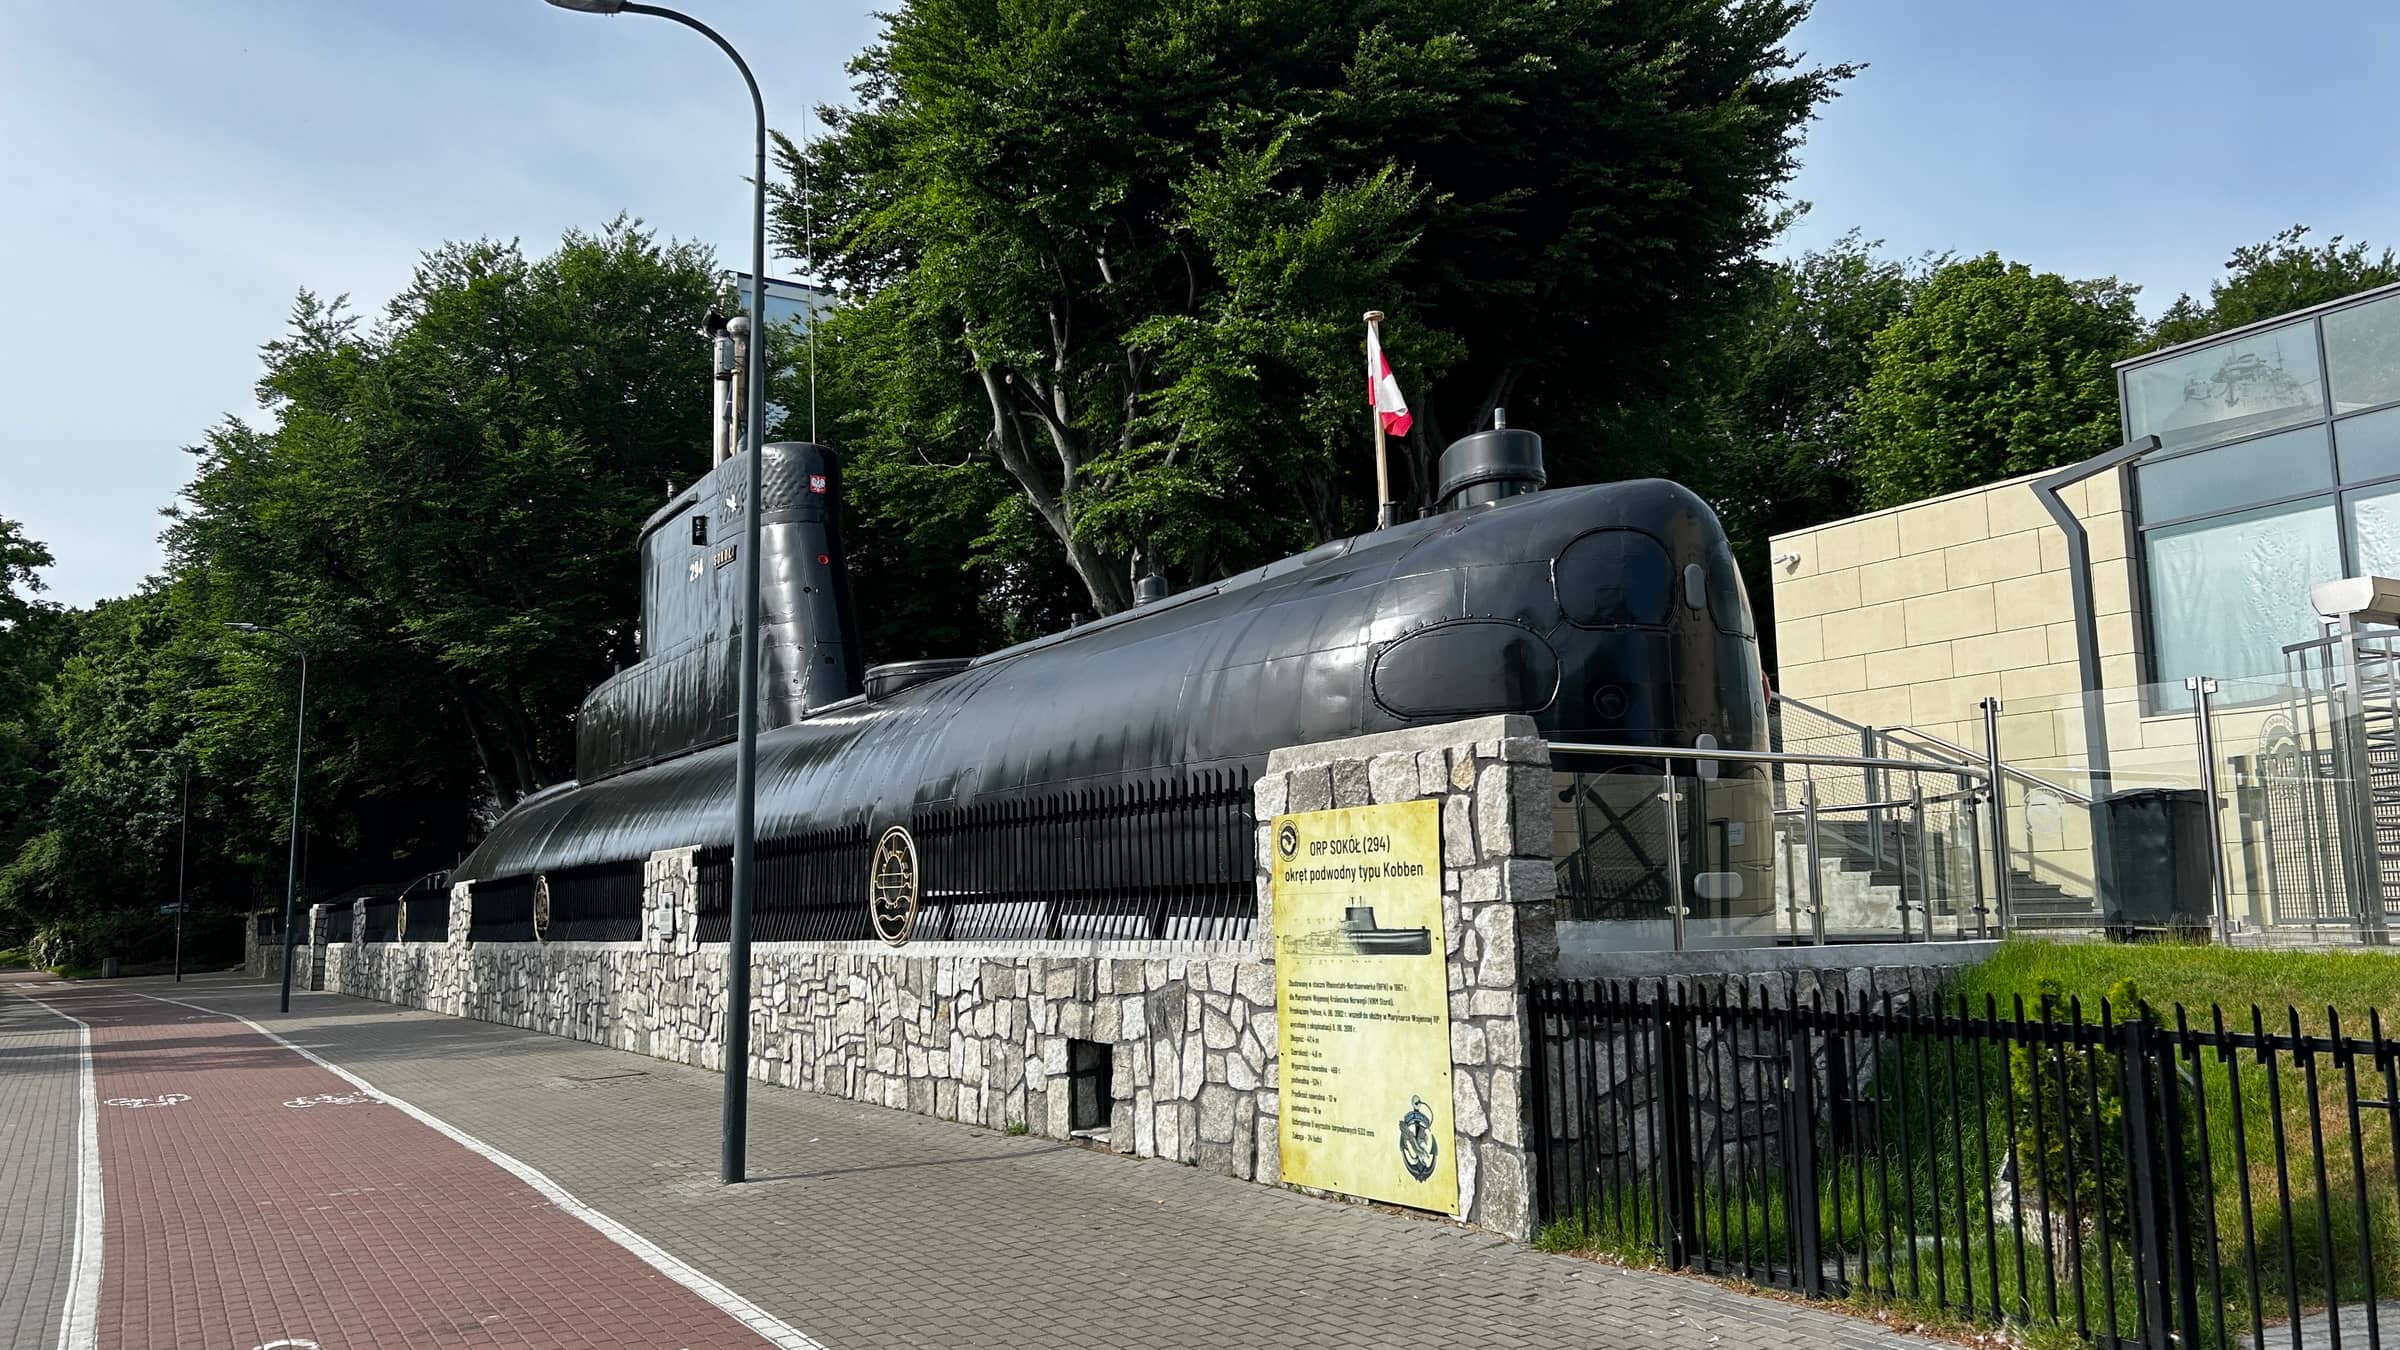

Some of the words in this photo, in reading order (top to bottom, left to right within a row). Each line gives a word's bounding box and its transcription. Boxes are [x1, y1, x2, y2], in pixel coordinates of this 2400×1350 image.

[690, 557, 703, 582] 294
[1310, 841, 1328, 856] ORP
[1330, 834, 1361, 855] SOKÓŁ
[1363, 834, 1390, 855] (294)
[1285, 867, 1308, 885] okręt
[1310, 864, 1356, 884] podwodny
[1359, 865, 1381, 882] typu
[1383, 860, 1424, 878] Kobben
